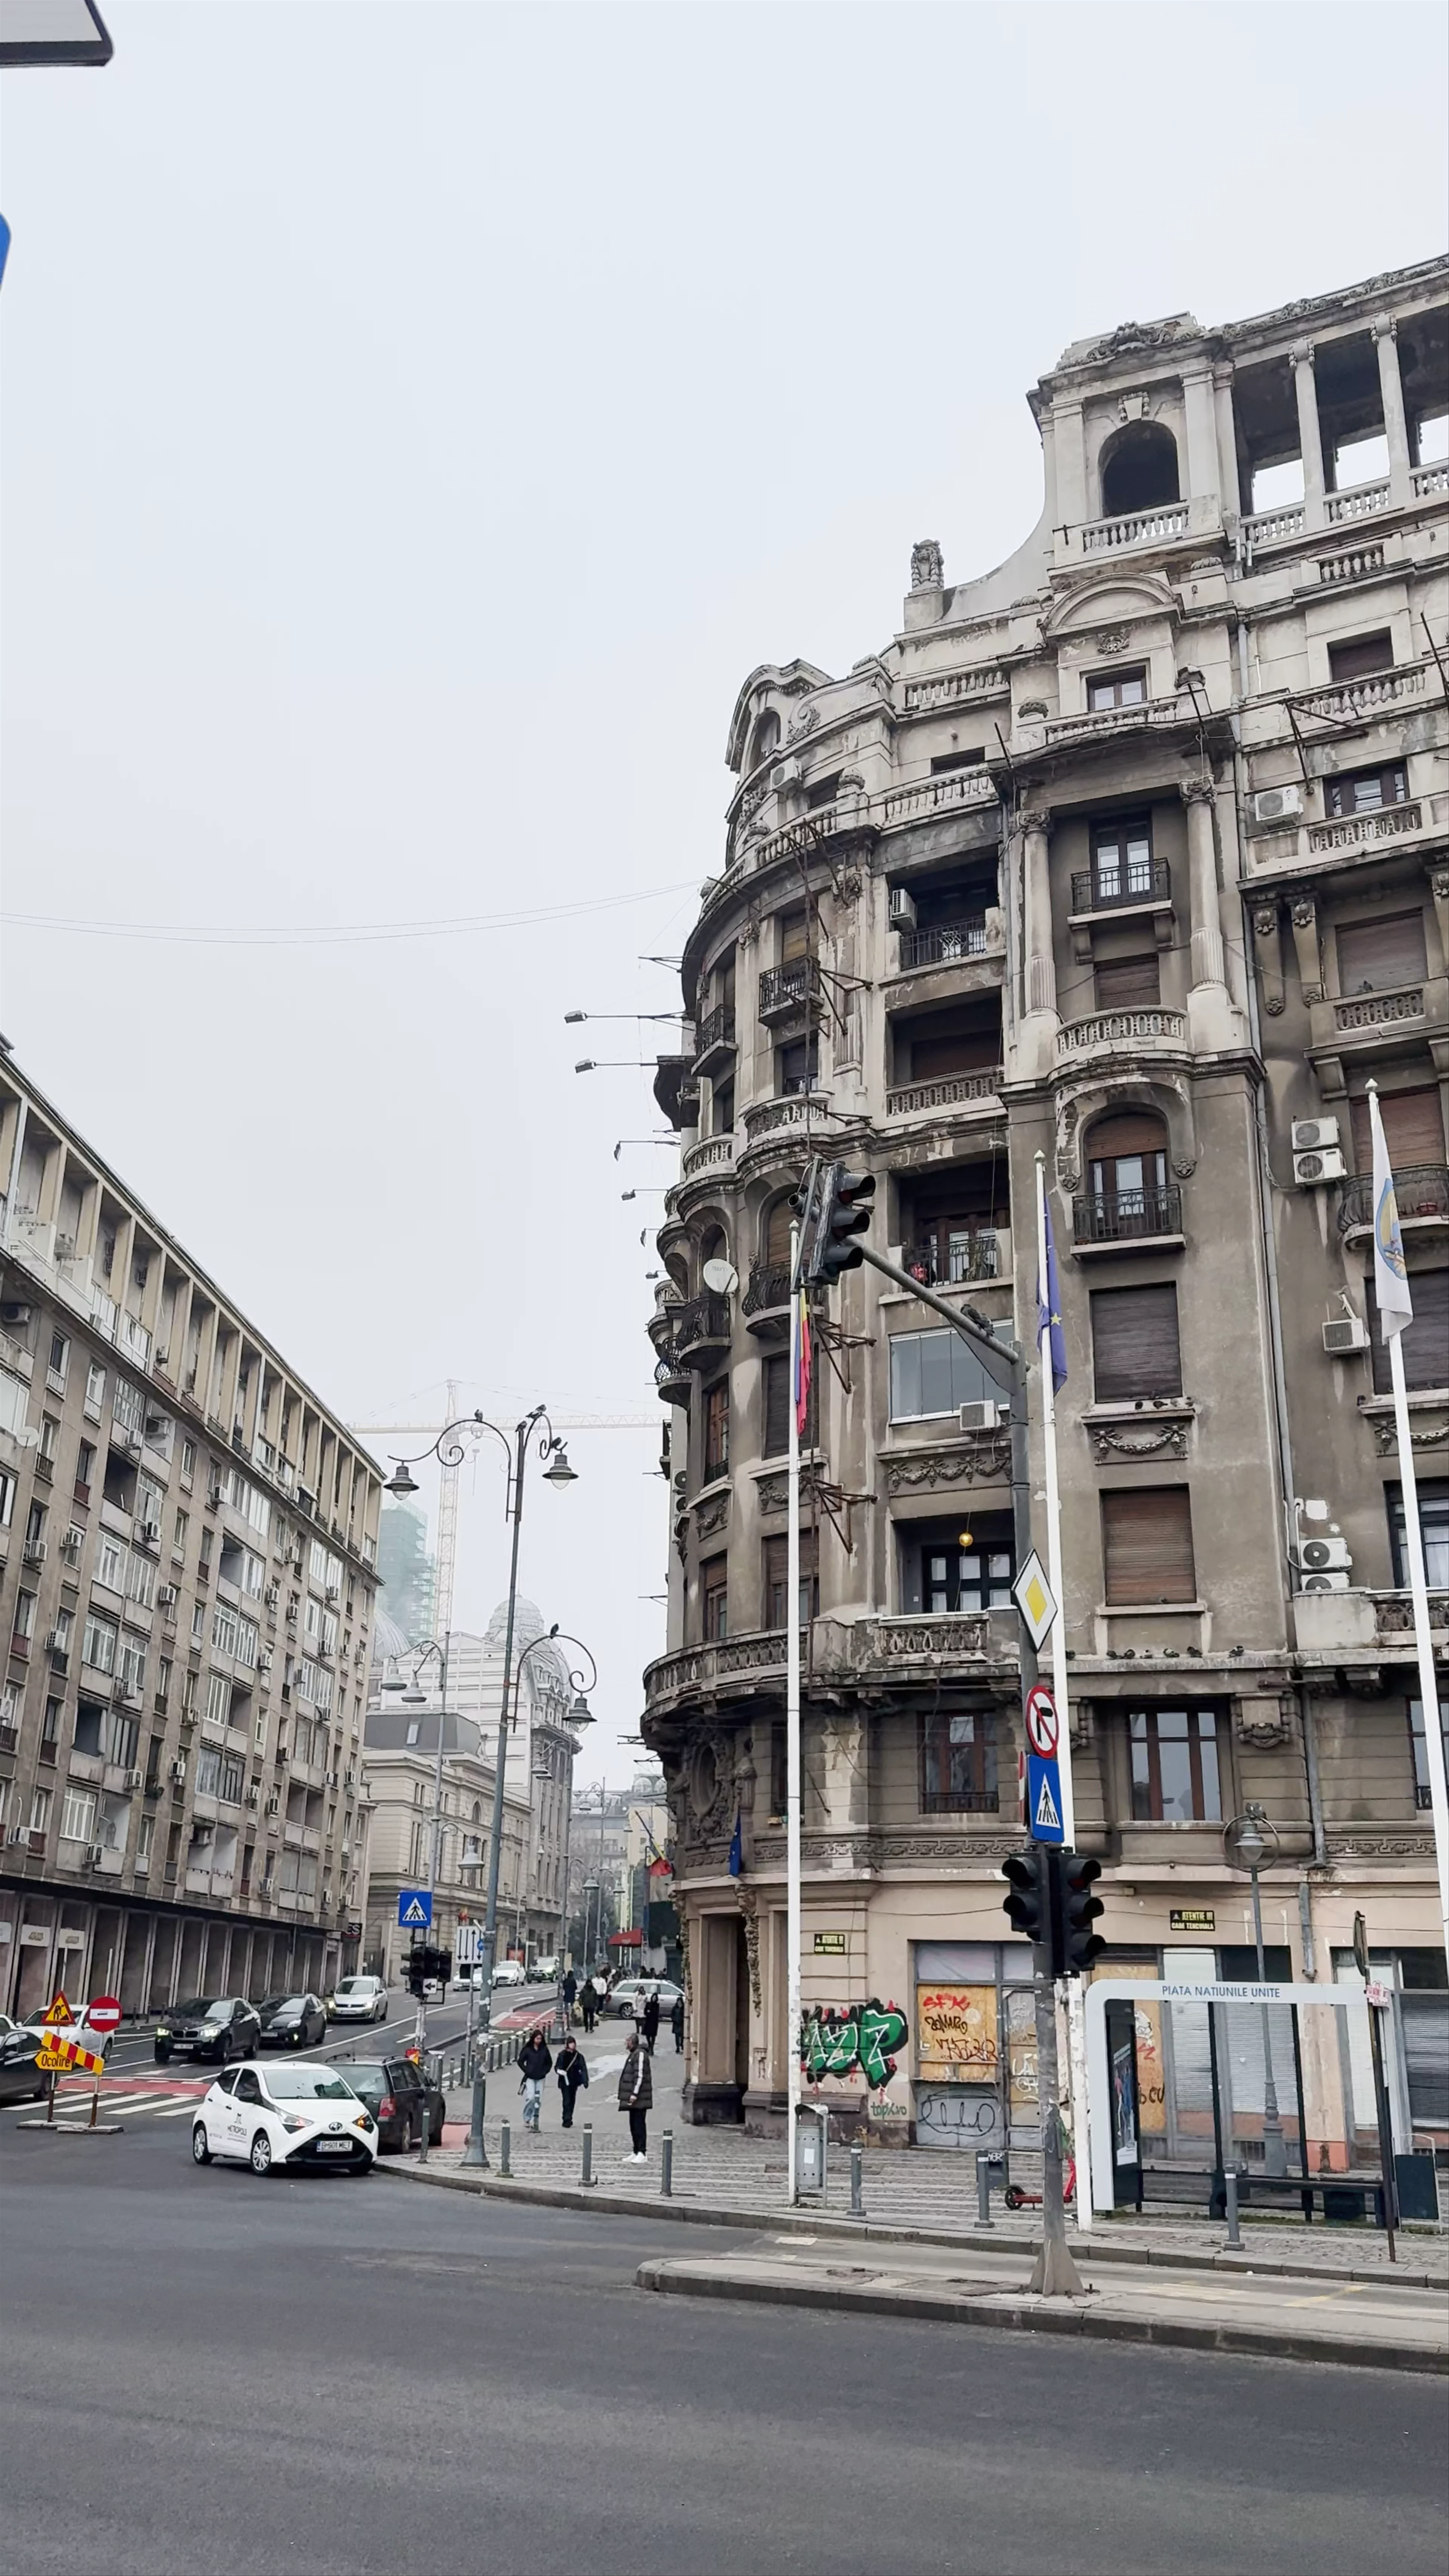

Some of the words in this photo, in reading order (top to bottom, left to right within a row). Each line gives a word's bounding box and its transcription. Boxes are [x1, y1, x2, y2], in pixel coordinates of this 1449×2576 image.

[1163, 1986, 1192, 1995] PIATA
[1195, 1987, 1248, 1997] NATIUNILE
[1251, 1988, 1280, 1998] UNITE
[41, 2054, 70, 2067] Ocolire
